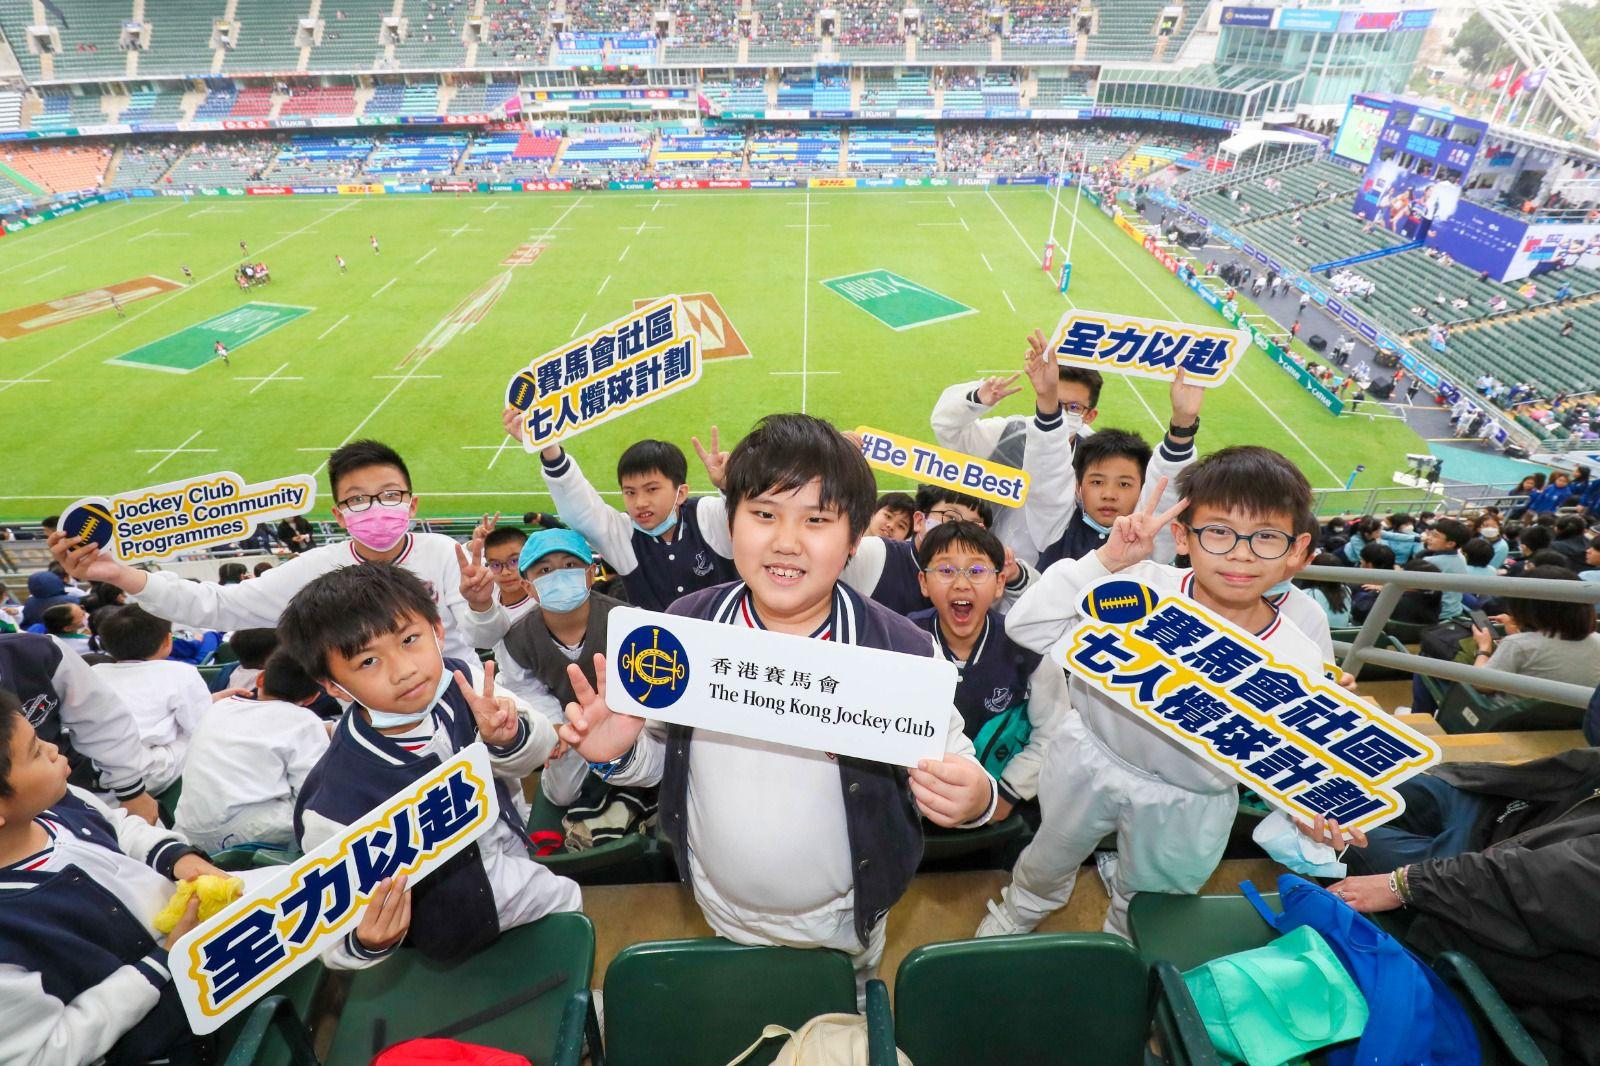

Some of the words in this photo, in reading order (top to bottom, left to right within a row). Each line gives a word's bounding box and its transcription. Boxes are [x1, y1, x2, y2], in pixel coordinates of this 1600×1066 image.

[537, 304, 673, 399] 賽馬會社區
[1057, 321, 1231, 376] 全力以赴
[528, 340, 692, 441] 七人欖球計劃
[860, 434, 907, 466] #Be
[912, 448, 959, 481] The
[962, 463, 1023, 500] Best
[114, 492, 183, 520] Jockey
[188, 482, 234, 504] Club
[117, 513, 189, 538] Sevens
[193, 487, 304, 523] Community
[121, 519, 243, 557] Programmes
[710, 657, 841, 695] 香港賽馬會
[1135, 604, 1422, 778] 賽馬會社區
[709, 682, 739, 703] The
[743, 689, 786, 715] Hong
[789, 698, 832, 723] Kong
[832, 706, 892, 734] Jockey
[894, 717, 936, 739] Club
[1073, 631, 1387, 826] 七人欖球計劃
[203, 770, 480, 1006] 全力以赴
